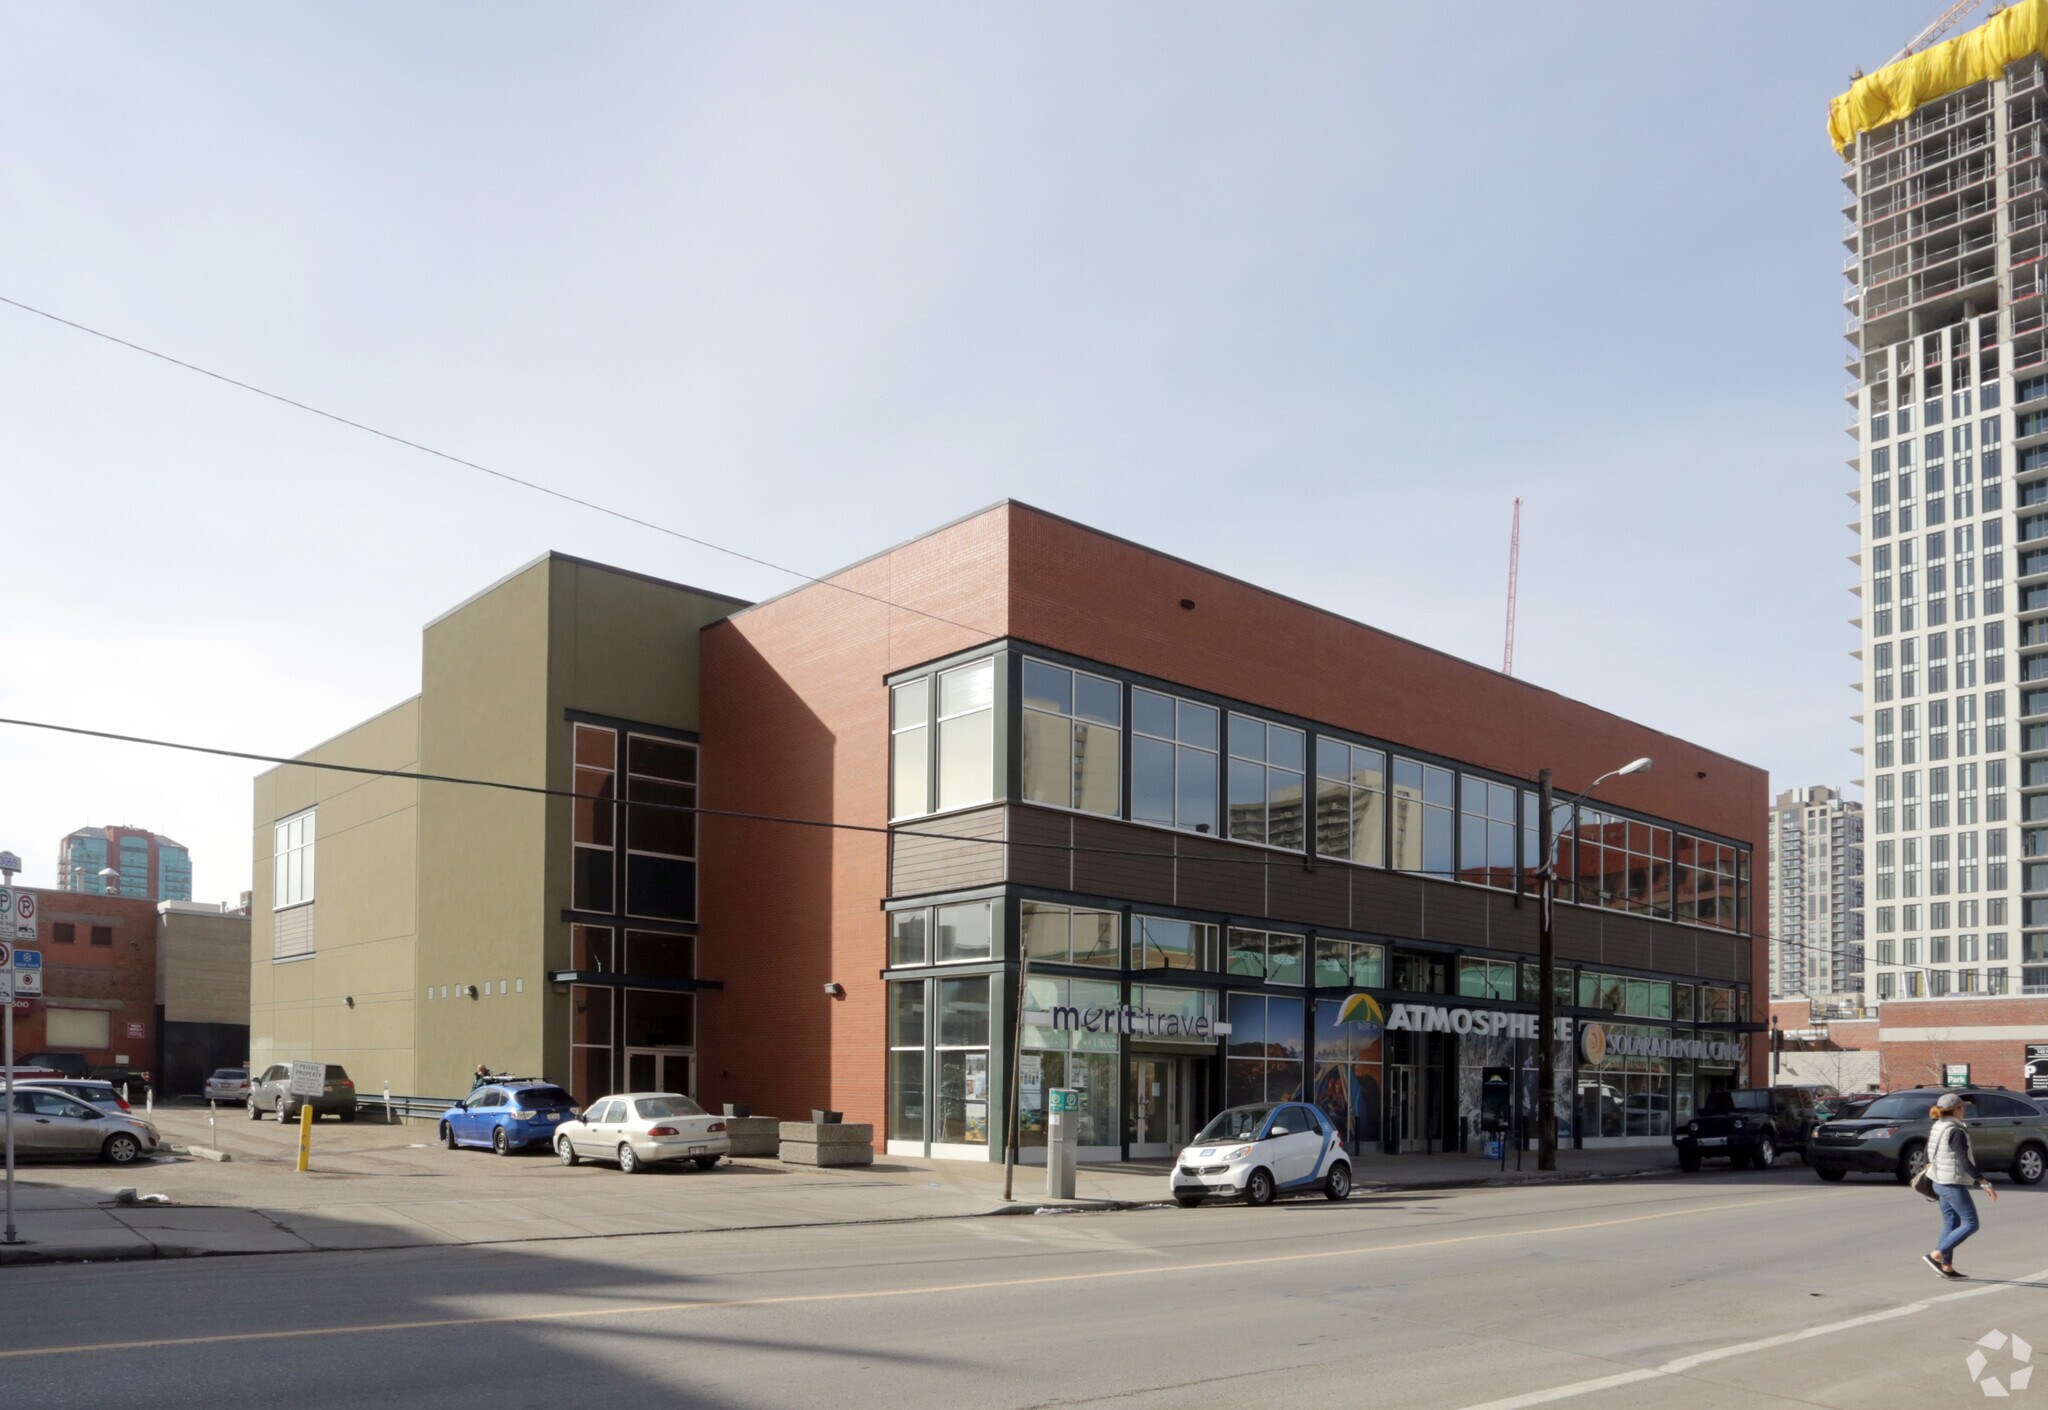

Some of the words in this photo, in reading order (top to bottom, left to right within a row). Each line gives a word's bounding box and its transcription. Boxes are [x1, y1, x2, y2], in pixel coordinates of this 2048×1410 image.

[1053, 1004, 1136, 1034] merit
[1145, 1005, 1215, 1038] travel
[1386, 1003, 1574, 1041] ATMOSPHEE
[1606, 1034, 1664, 1057] SOLARA
[1664, 1038, 1710, 1060] DENTAL
[1948, 1075, 1965, 1084] Park
